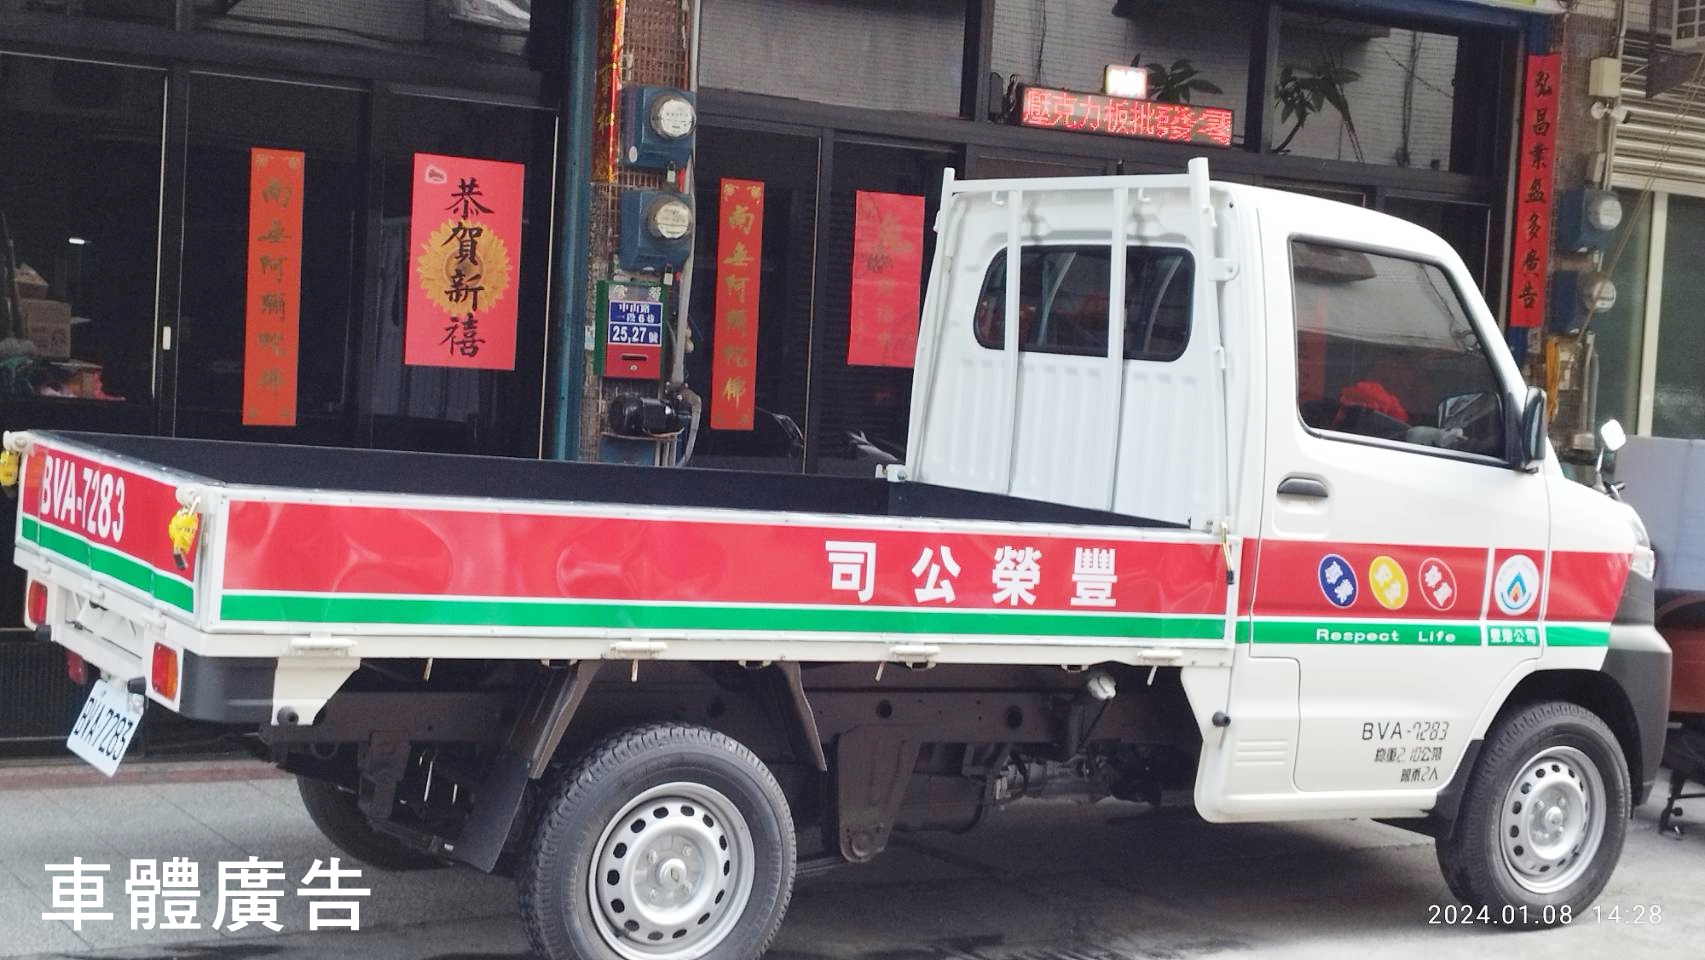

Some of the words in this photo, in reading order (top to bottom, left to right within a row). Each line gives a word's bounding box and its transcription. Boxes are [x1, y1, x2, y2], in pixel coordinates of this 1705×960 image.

[439, 177, 495, 358] 恭賀新禧
[40, 455, 126, 544] BVA-7283
[1316, 628, 1400, 643] Respect
[1418, 630, 1457, 643] Life
